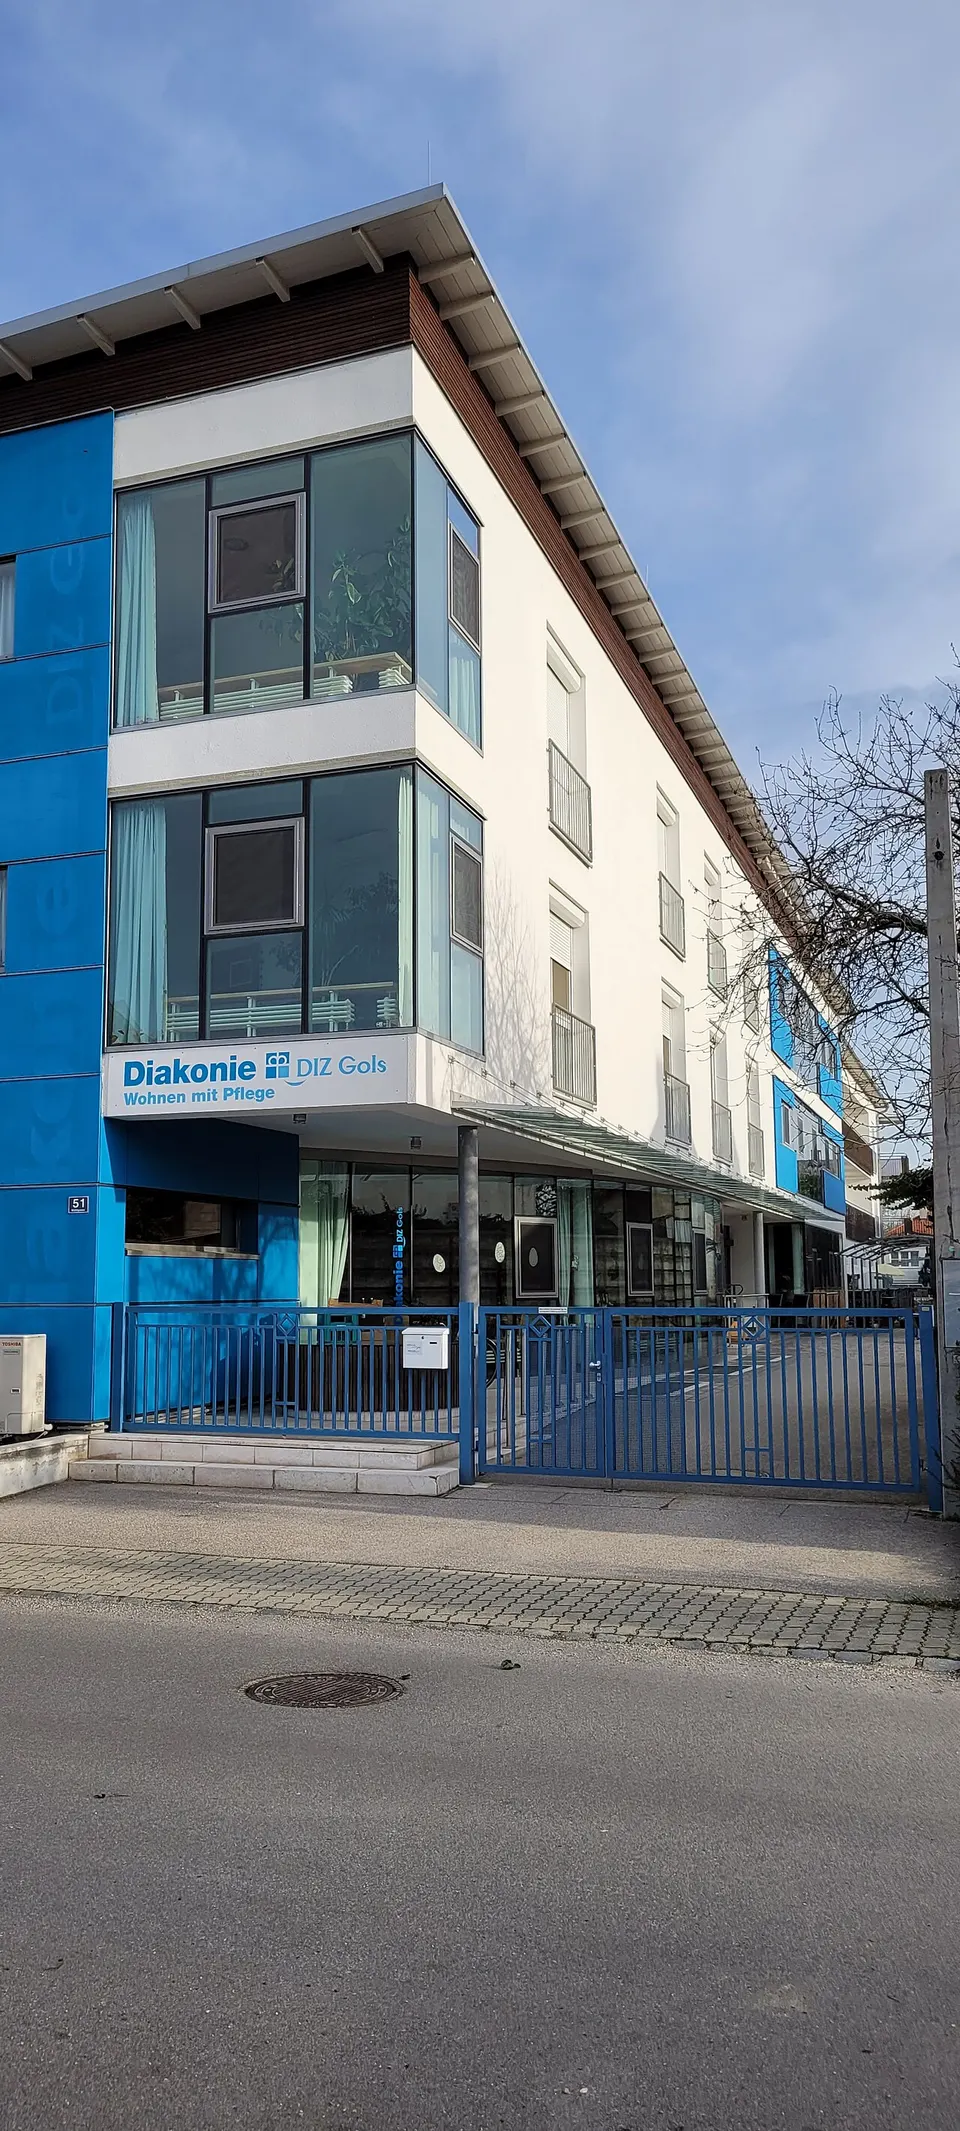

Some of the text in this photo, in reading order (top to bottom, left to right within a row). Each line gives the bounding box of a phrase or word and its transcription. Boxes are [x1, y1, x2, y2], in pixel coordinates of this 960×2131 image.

[123, 1054, 387, 1087] Diakonie DIZ Gols
[123, 1086, 275, 1106] Wohnen mit Pflege
[72, 1198, 85, 1209] 51
